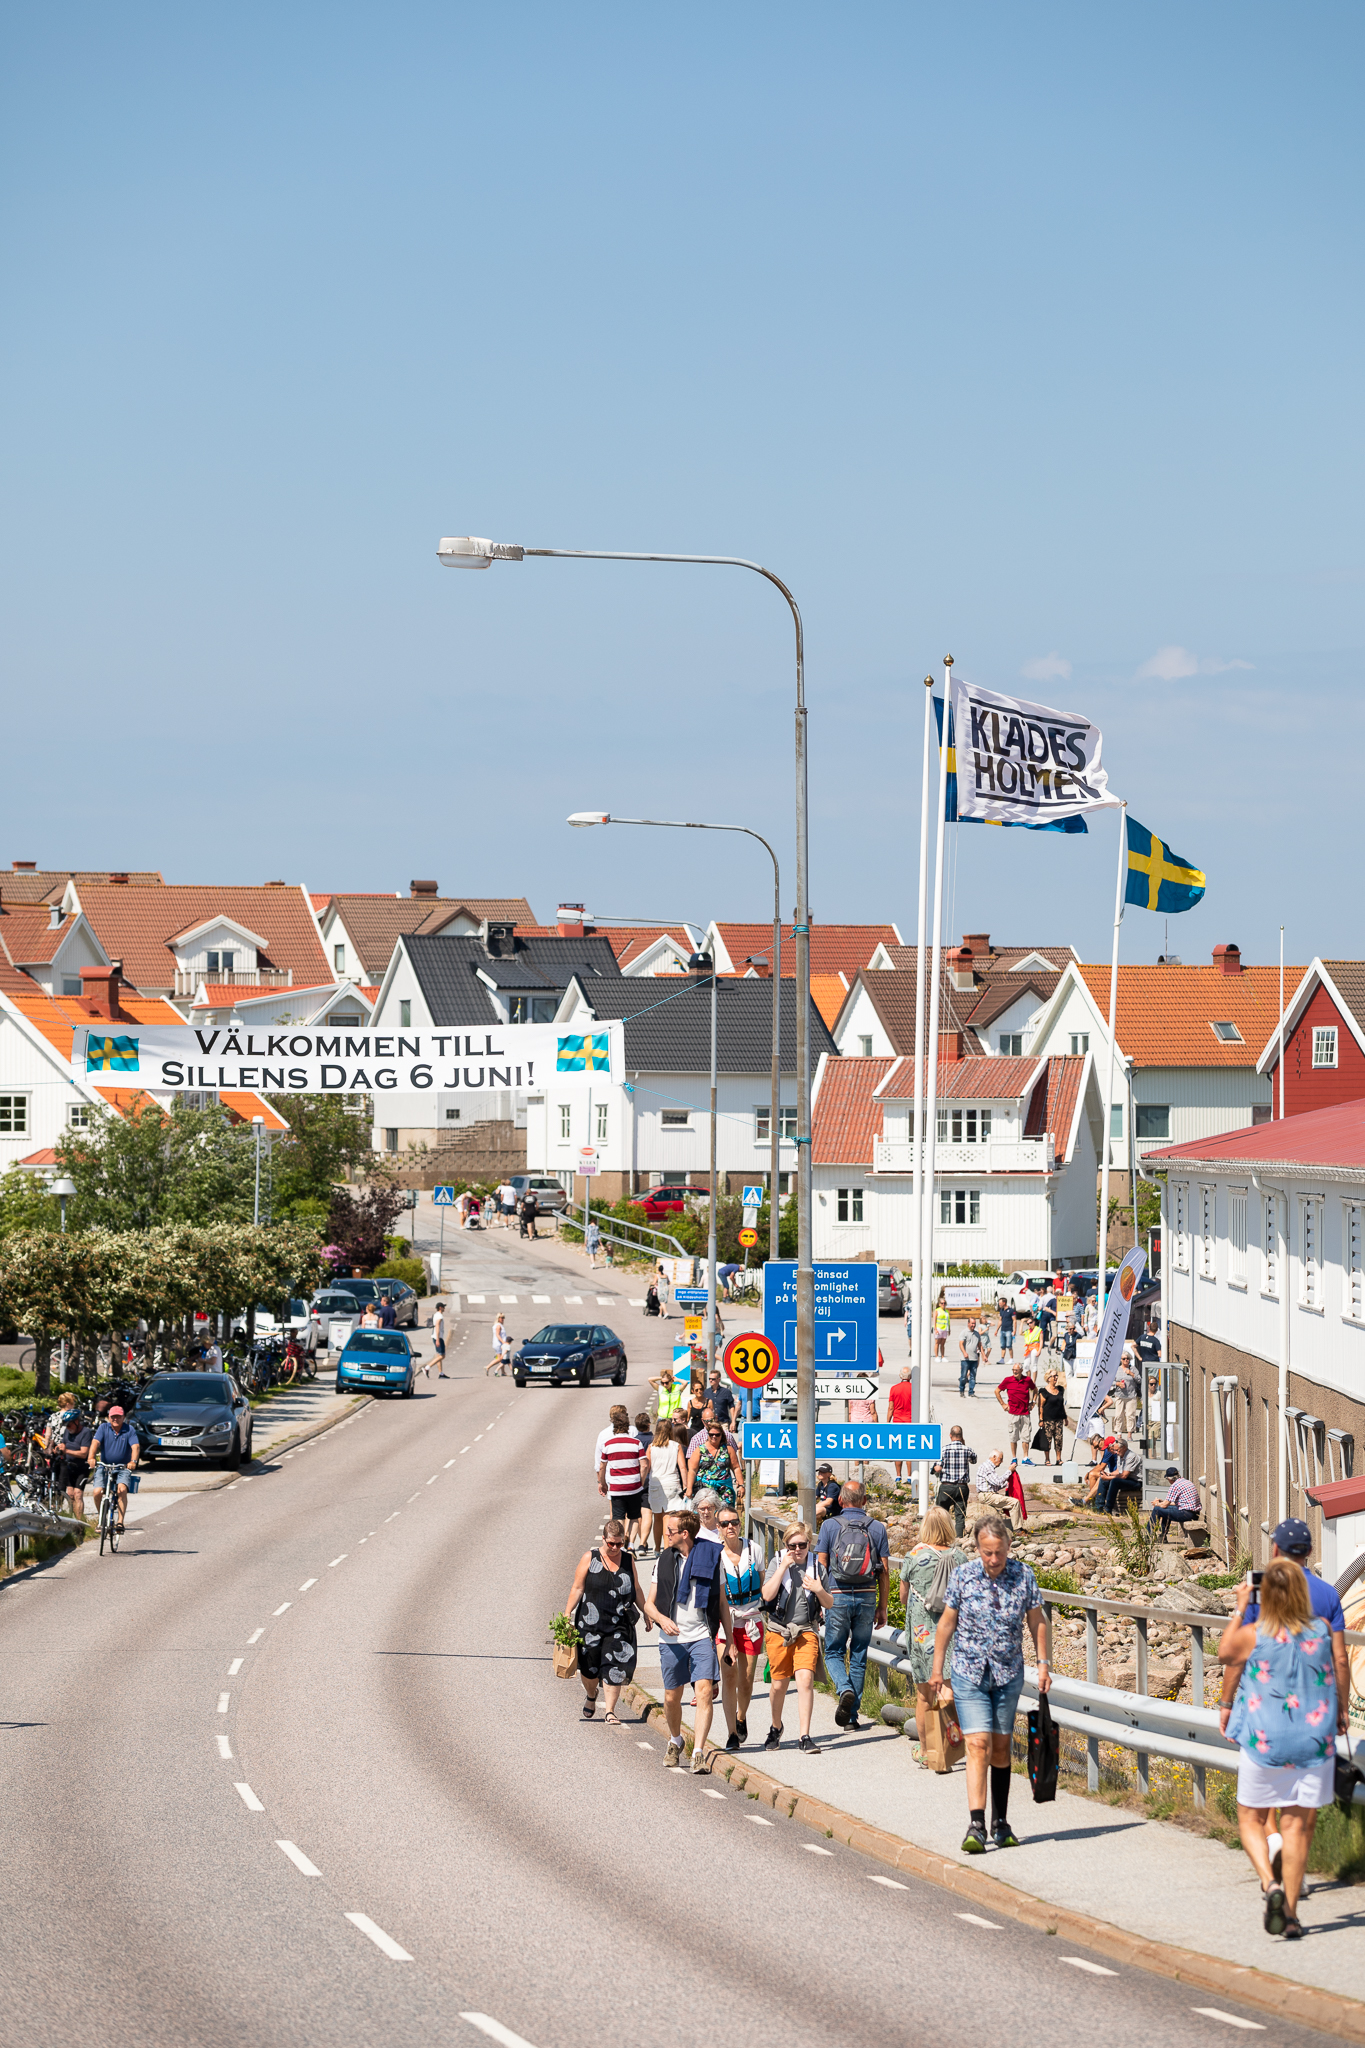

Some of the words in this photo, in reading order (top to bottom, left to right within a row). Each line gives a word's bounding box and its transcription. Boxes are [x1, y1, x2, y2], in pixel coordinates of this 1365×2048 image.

[970, 706, 1087, 772] KLÄDES
[973, 752, 1102, 800] HOLMEN
[194, 1028, 421, 1057] VÄLKOMMEN
[431, 1035, 505, 1057] TILL
[161, 1061, 308, 1089] SILLENS
[320, 1064, 398, 1089] DAG
[409, 1063, 434, 1089] 6
[444, 1061, 535, 1089] JUNI!
[783, 1282, 859, 1293] fraomlighet
[792, 1270, 849, 1279] Bänsad
[775, 1294, 789, 1304] på
[792, 1294, 866, 1304] Kesholmen
[1096, 1308, 1122, 1381] Sparbank
[734, 1347, 771, 1374] 30
[815, 1384, 830, 1393] ALT
[834, 1384, 841, 1394] &
[845, 1384, 865, 1394] SILL
[751, 1428, 934, 1450] KLÄESHOLMEN
